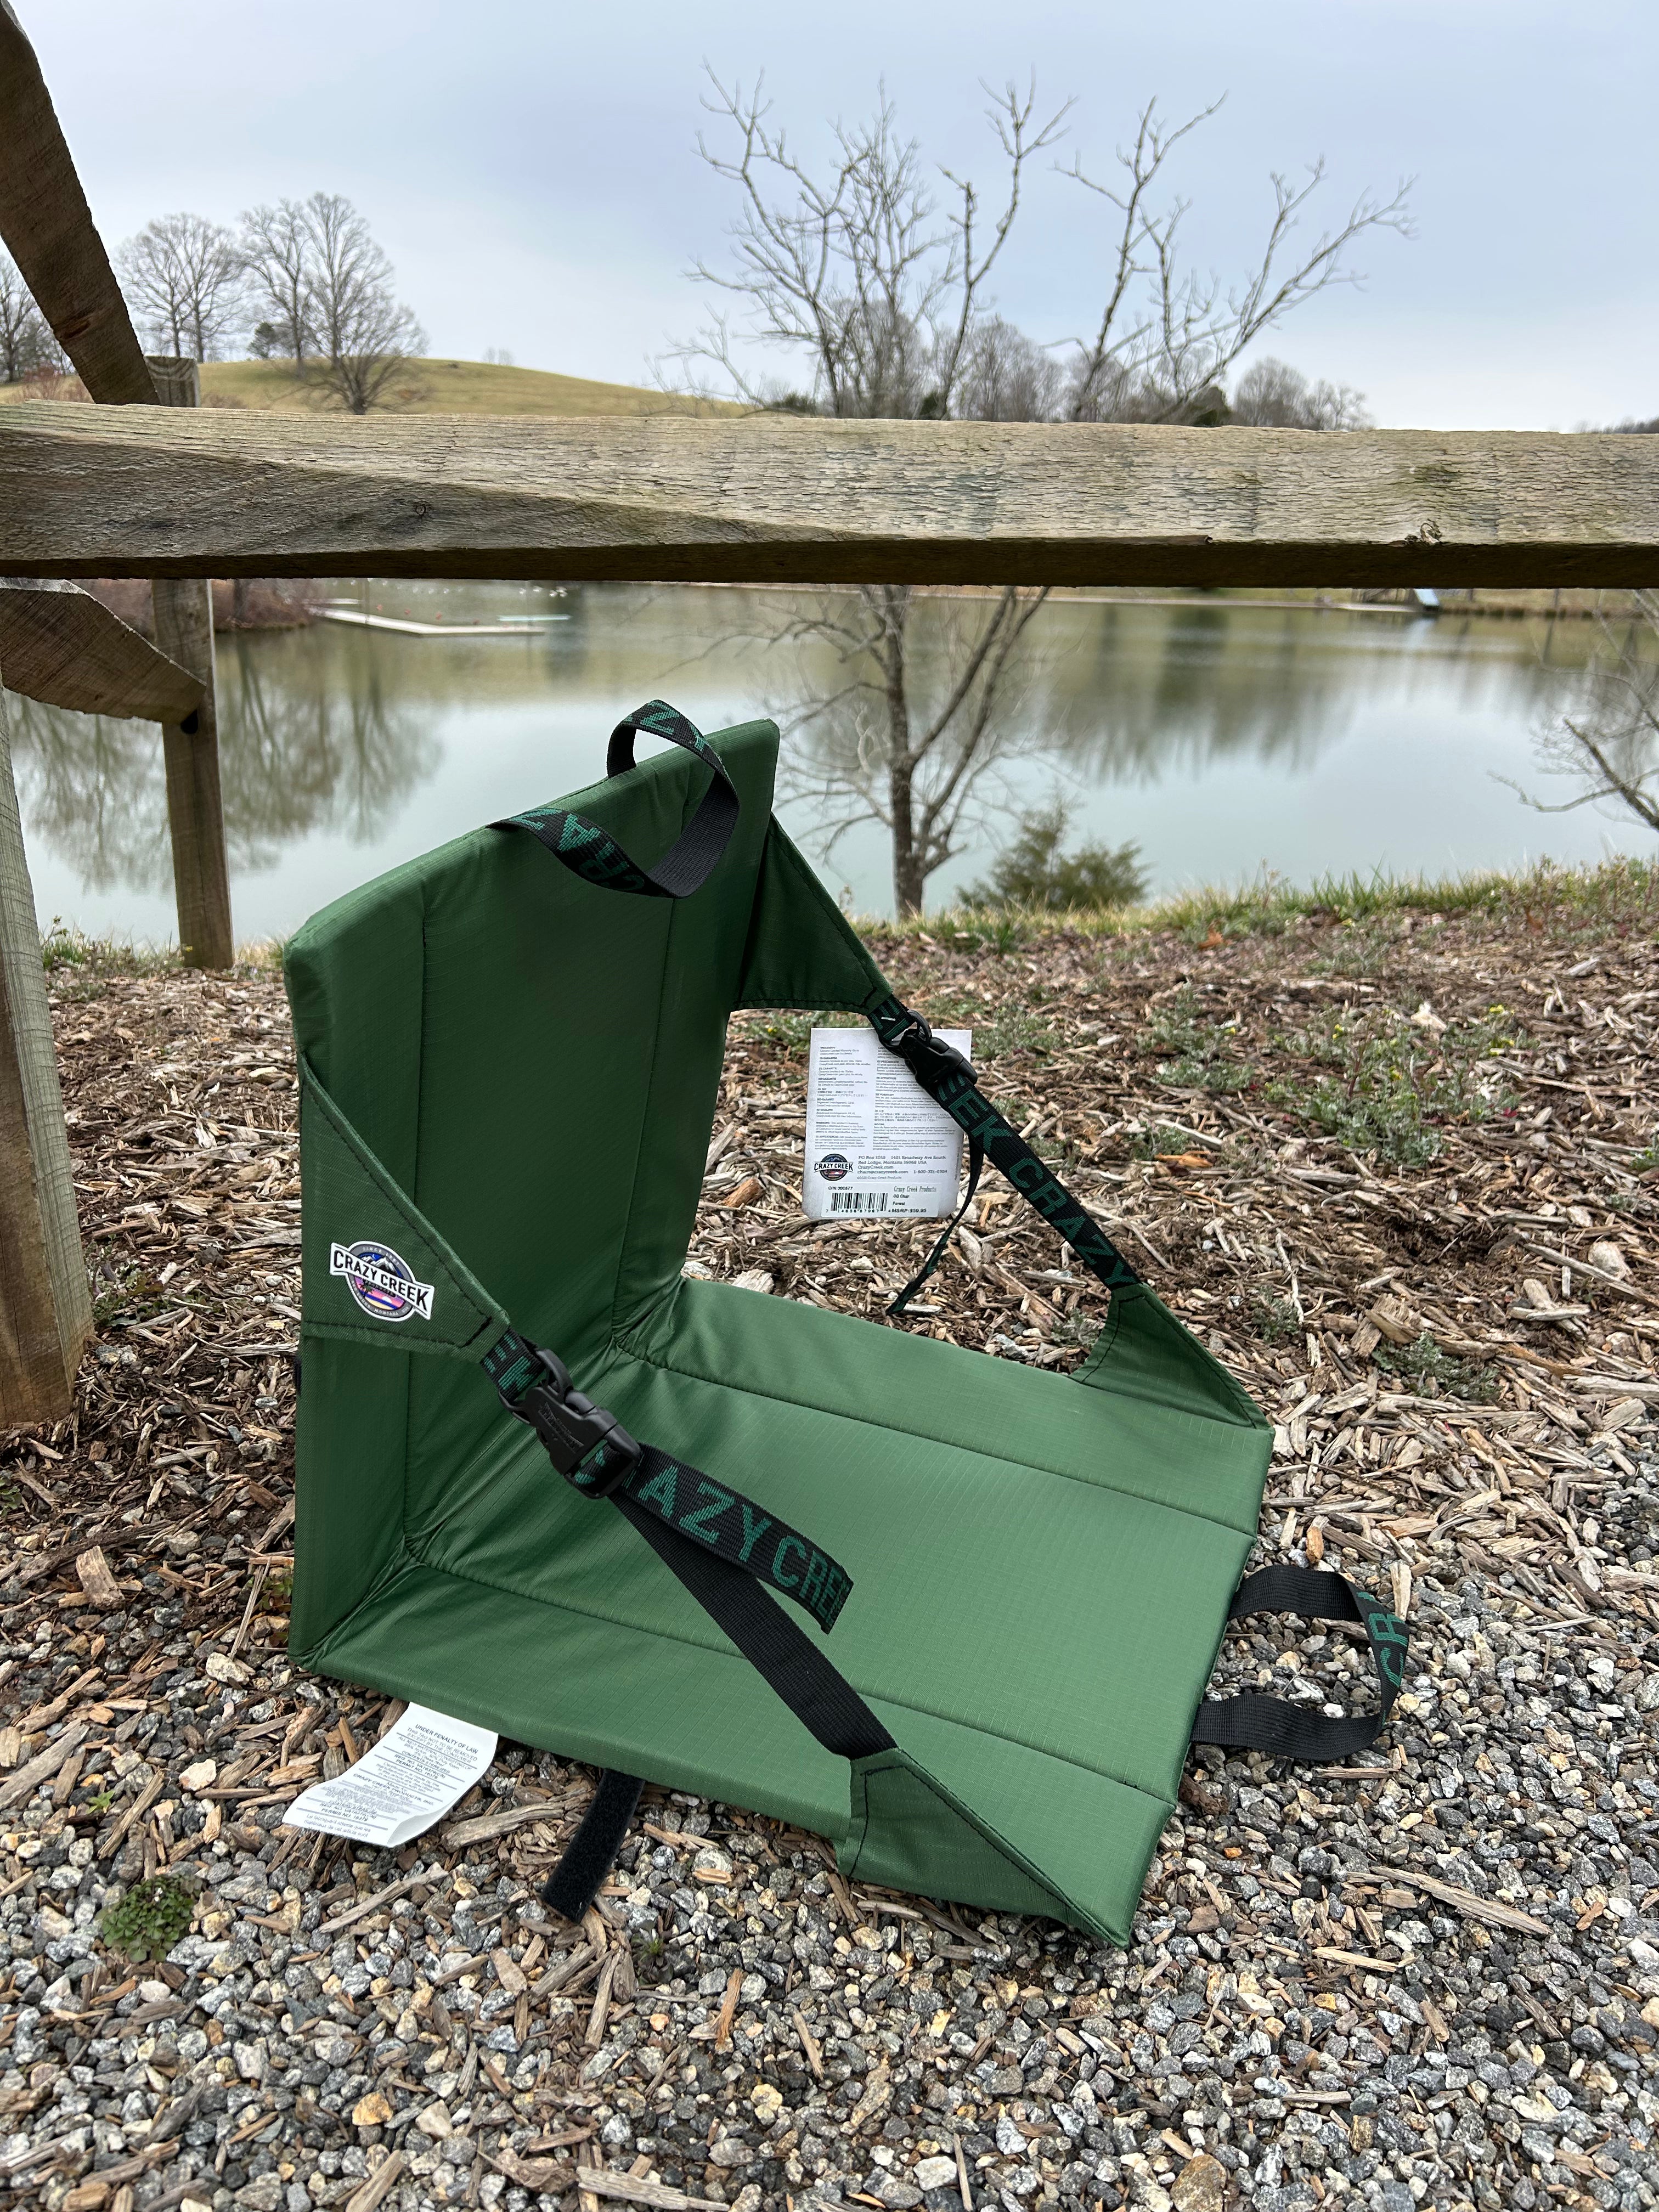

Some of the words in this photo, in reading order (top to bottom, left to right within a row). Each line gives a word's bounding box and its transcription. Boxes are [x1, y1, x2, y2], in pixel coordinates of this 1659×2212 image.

[814, 1163, 833, 1171] CRAZY
[834, 1163, 854, 1171] CREEK
[1008, 1158, 1136, 1285] CRAZY
[334, 1250, 377, 1281] CRAZY
[381, 1273, 430, 1312] CREEK
[627, 1464, 772, 1563] AZY
[415, 1724, 433, 1735] UNDER
[434, 1733, 458, 1745] PENALTY
